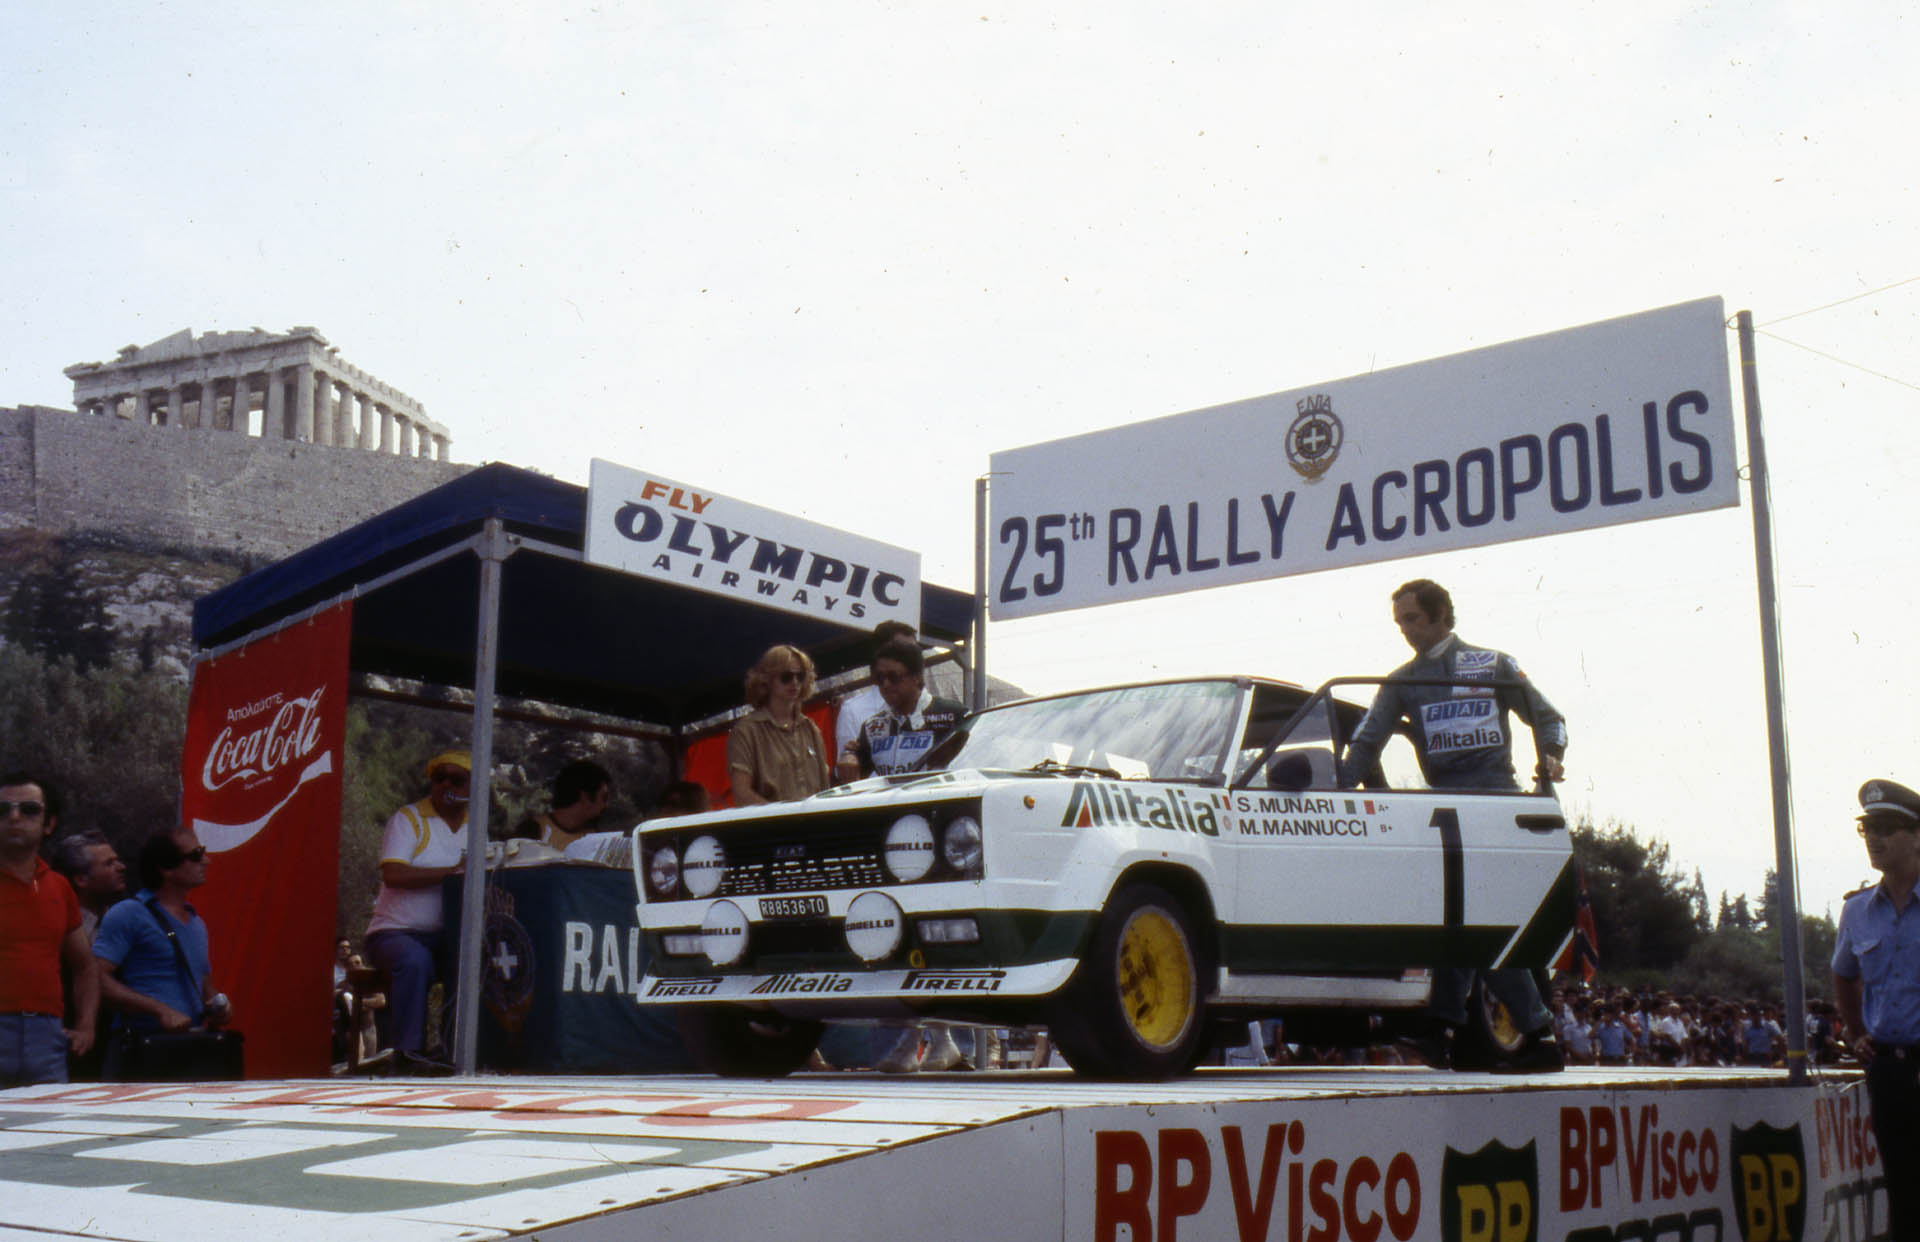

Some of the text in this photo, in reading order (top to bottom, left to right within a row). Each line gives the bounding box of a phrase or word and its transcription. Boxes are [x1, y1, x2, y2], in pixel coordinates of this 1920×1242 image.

[641, 480, 712, 514] FLY
[1000, 391, 1712, 603] 25th RALLY ACROPOLIS
[614, 501, 904, 606] OLYMPIC
[653, 554, 865, 618] AIRWAYS
[1427, 701, 1491, 721] FIAT
[1429, 729, 1500, 750] Alitalia
[1061, 782, 1219, 836] Alitalia
[1429, 808, 1465, 926] 1
[563, 921, 640, 994] RAL
[649, 977, 723, 997] PIRELLI
[750, 975, 853, 994] Alitalia
[900, 970, 1006, 991] PIRELLI
[1096, 1120, 1421, 1242] BP Visco
[1560, 1104, 1719, 1212] BP Visco
[1741, 1153, 1800, 1242] BP
